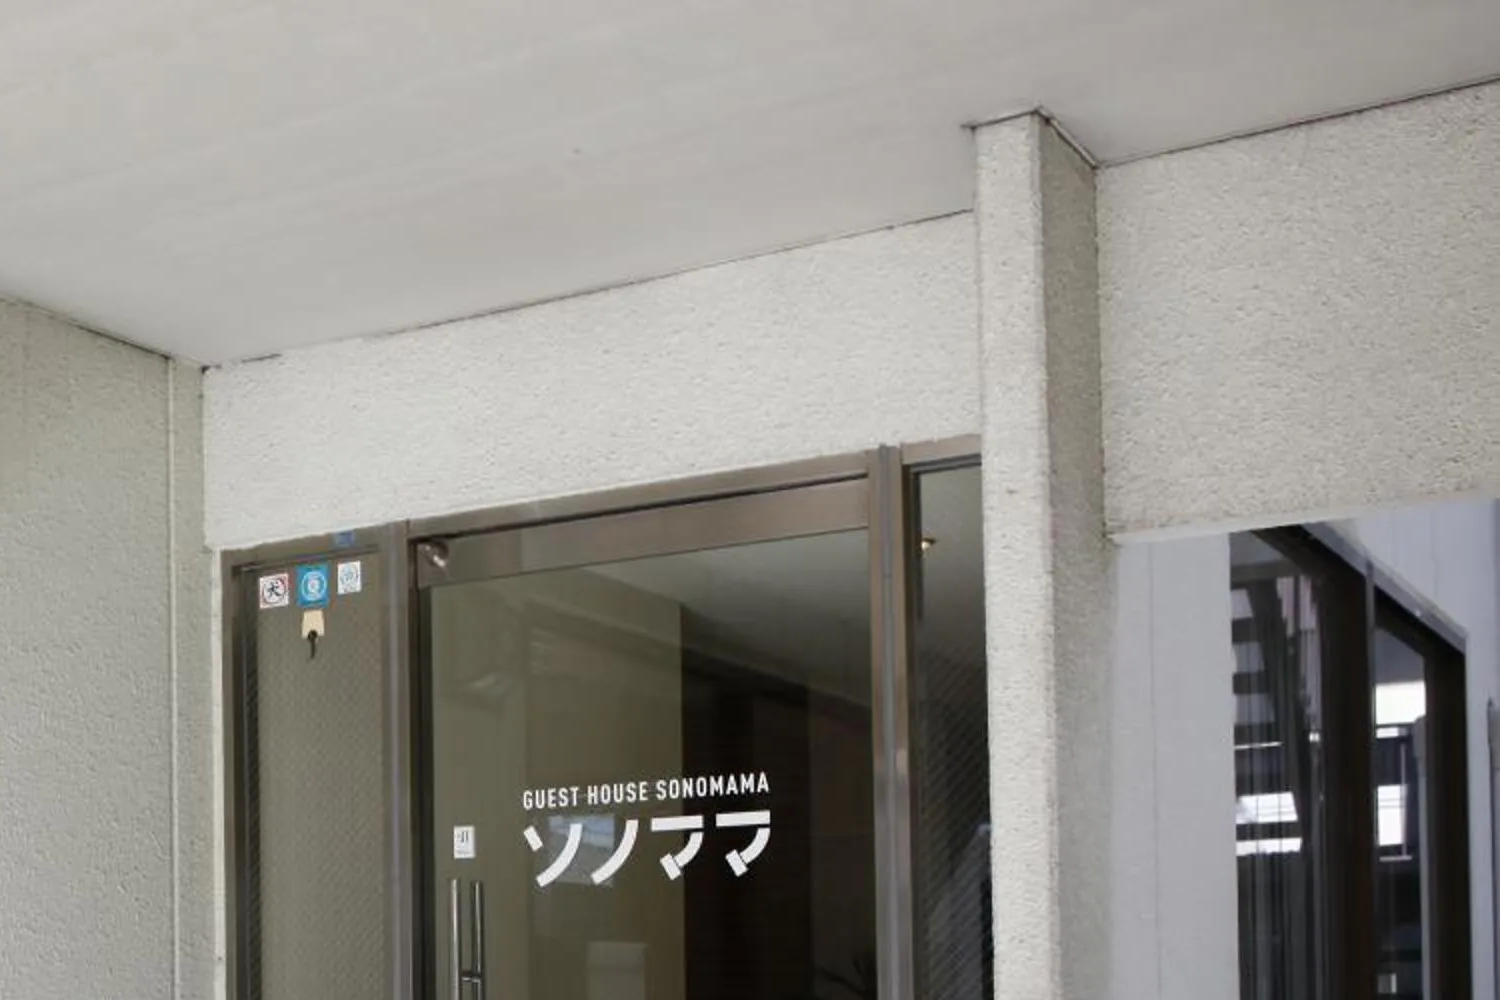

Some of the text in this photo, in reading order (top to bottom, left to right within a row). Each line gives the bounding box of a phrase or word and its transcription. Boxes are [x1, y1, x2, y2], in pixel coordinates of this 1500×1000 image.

[522, 772, 769, 811] GUEST HOUSE SONOMAMA
[523, 810, 771, 888] ソノママ
